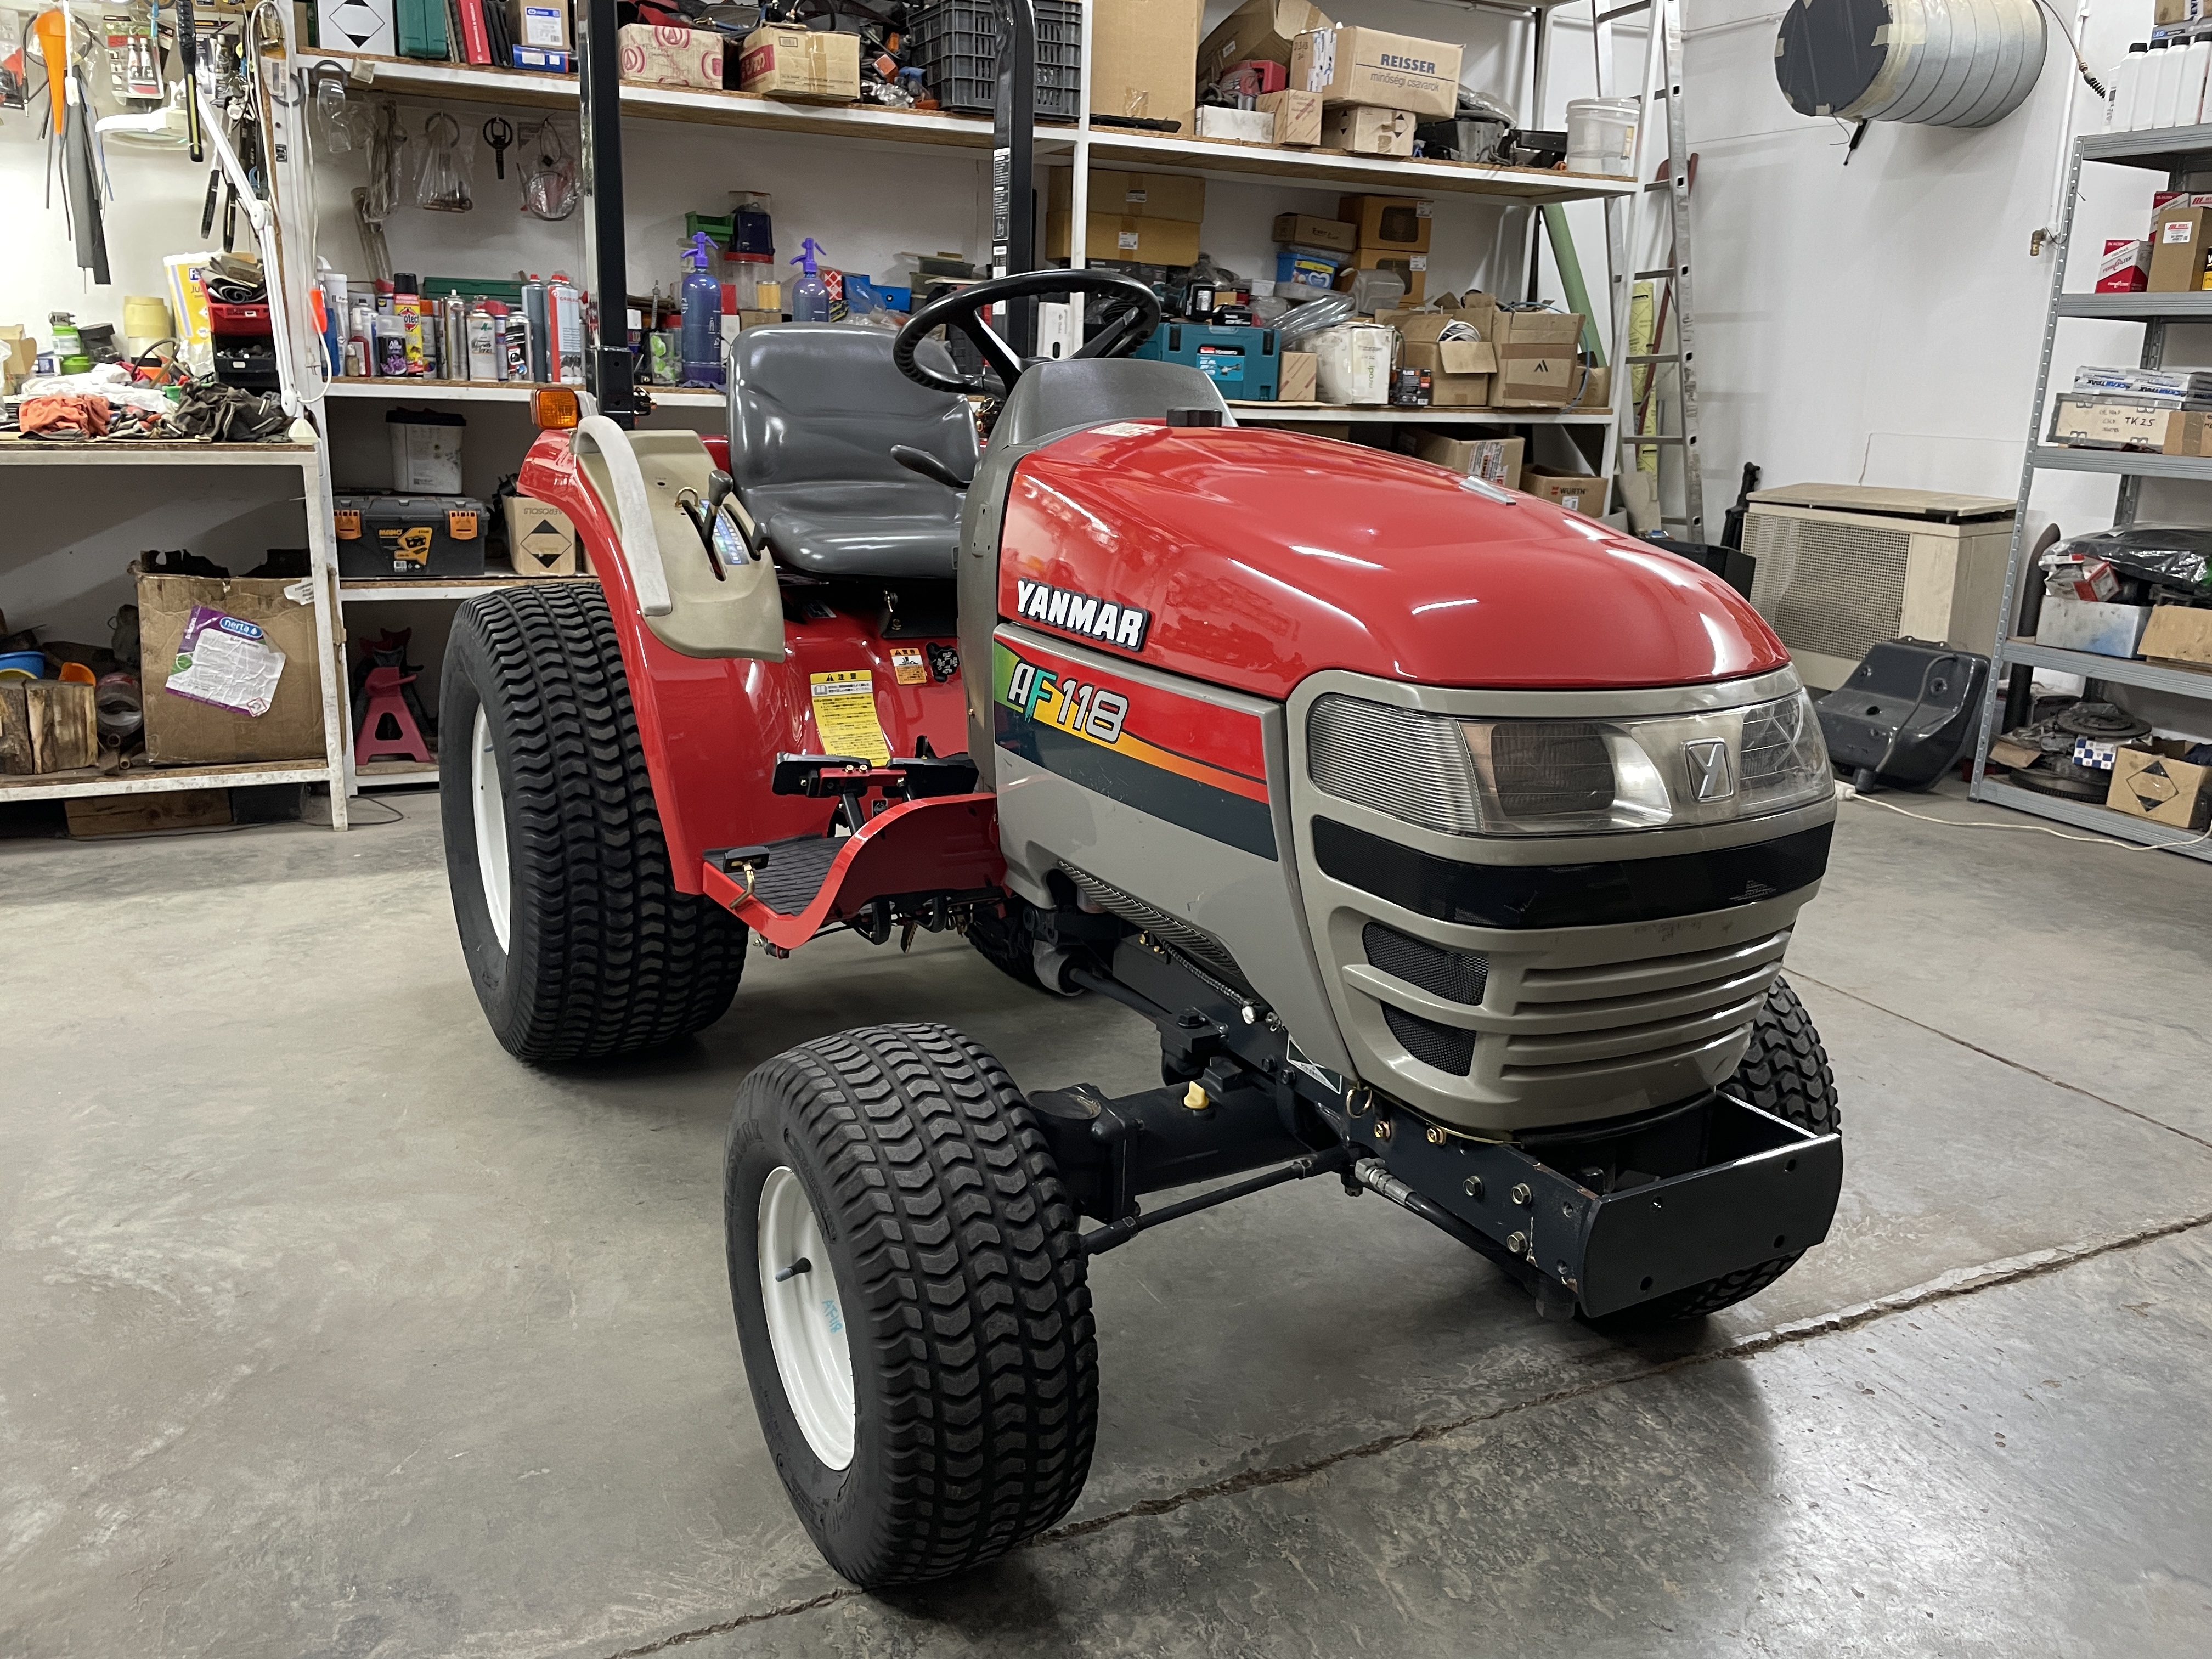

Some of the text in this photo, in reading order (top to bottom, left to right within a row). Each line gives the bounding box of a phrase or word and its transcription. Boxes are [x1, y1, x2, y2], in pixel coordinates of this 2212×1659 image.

[1380, 54, 1435, 74] REISSER
[1407, 78, 1440, 91] csavarok
[1017, 579, 1144, 648] YANMAR
[224, 619, 250, 632] nerta
[1008, 662, 1128, 743] AF118
